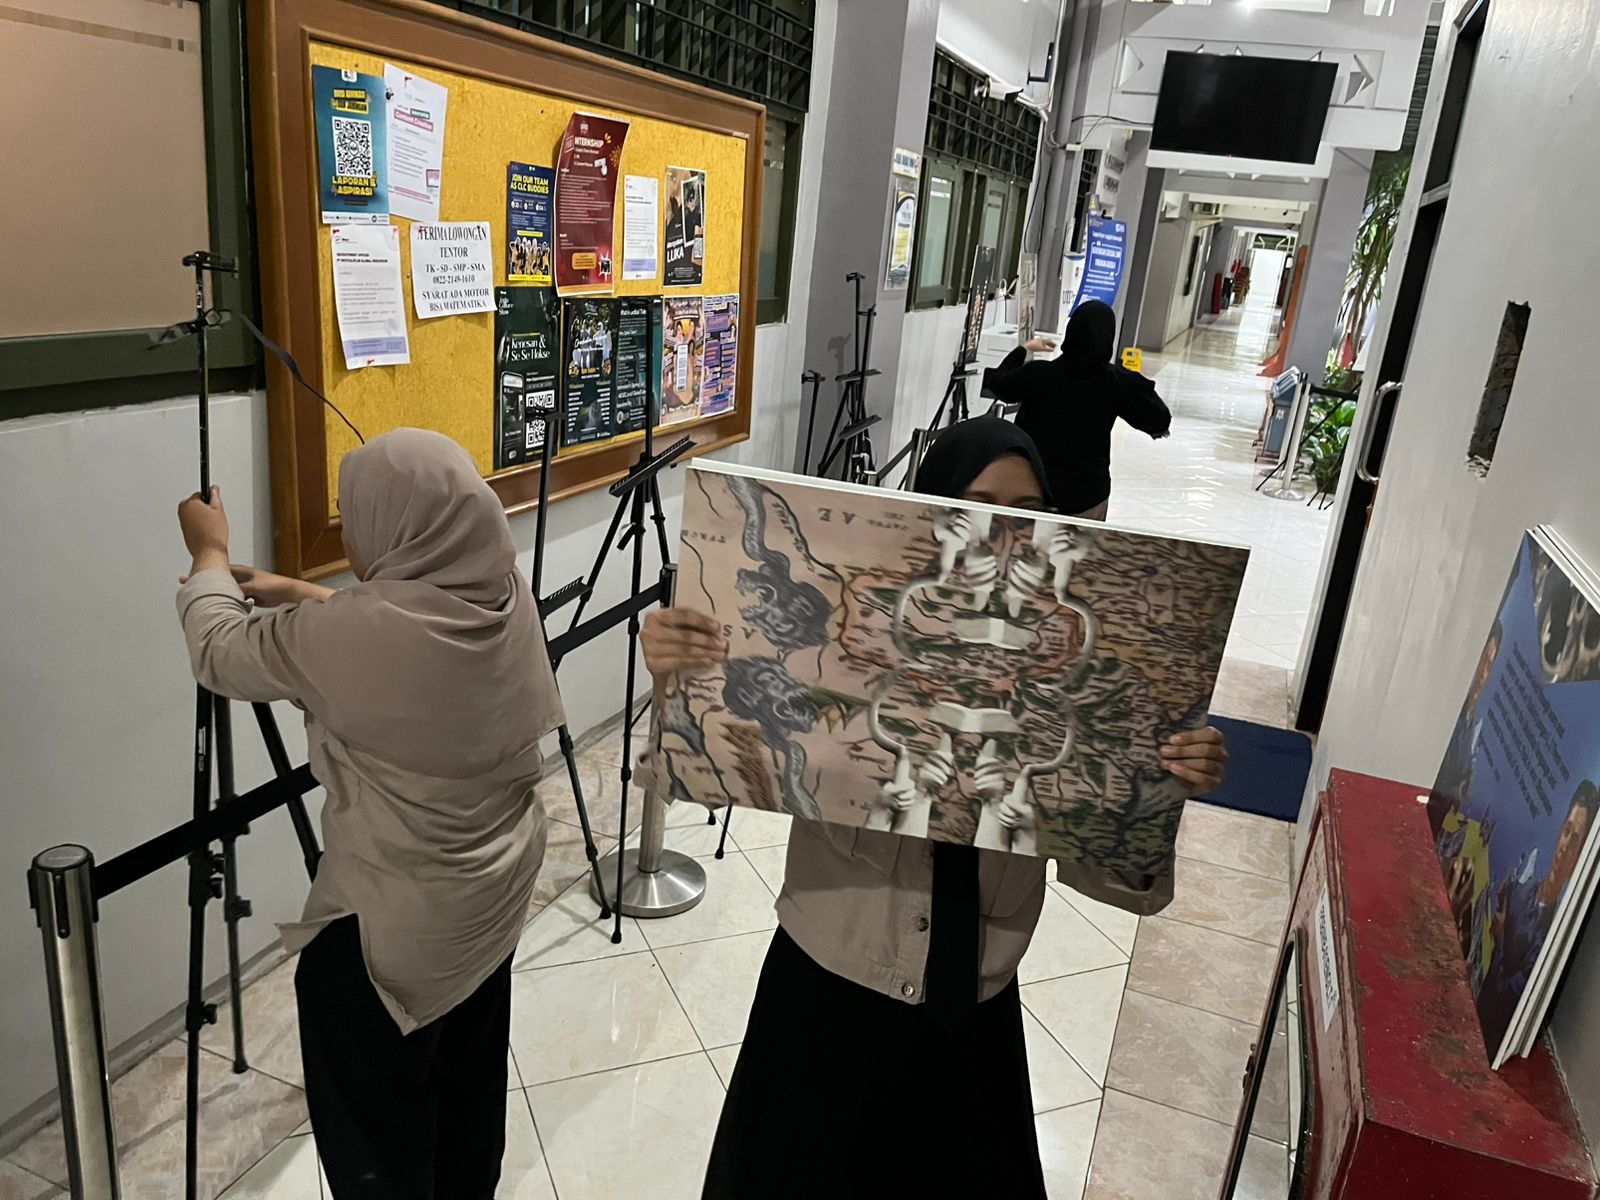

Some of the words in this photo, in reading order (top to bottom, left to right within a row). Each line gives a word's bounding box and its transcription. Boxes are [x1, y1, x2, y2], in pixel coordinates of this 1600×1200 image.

[574, 136, 604, 148] INTERNSHIP
[332, 175, 369, 186] LAPORAN
[512, 174, 522, 182] JOIN
[523, 175, 533, 184] OUR
[534, 177, 549, 187] TEAM
[337, 186, 372, 196] ASPIRASI
[510, 182, 517, 190] AS
[518, 183, 527, 191] CLC
[528, 184, 549, 194] BUDDIES
[418, 224, 448, 240] TERIMA
[448, 224, 487, 240] LOWONGAN
[440, 246, 469, 258] TENTOR
[667, 245, 685, 263] LUKA
[426, 264, 435, 273] TK
[440, 264, 449, 273] SD
[453, 264, 466, 272] SMP
[471, 263, 486, 271] SMA
[422, 290, 448, 300] SYARAT
[450, 290, 463, 298] ADA
[464, 288, 490, 297] MOTOR
[443, 300, 487, 310] MATEMATIKA
